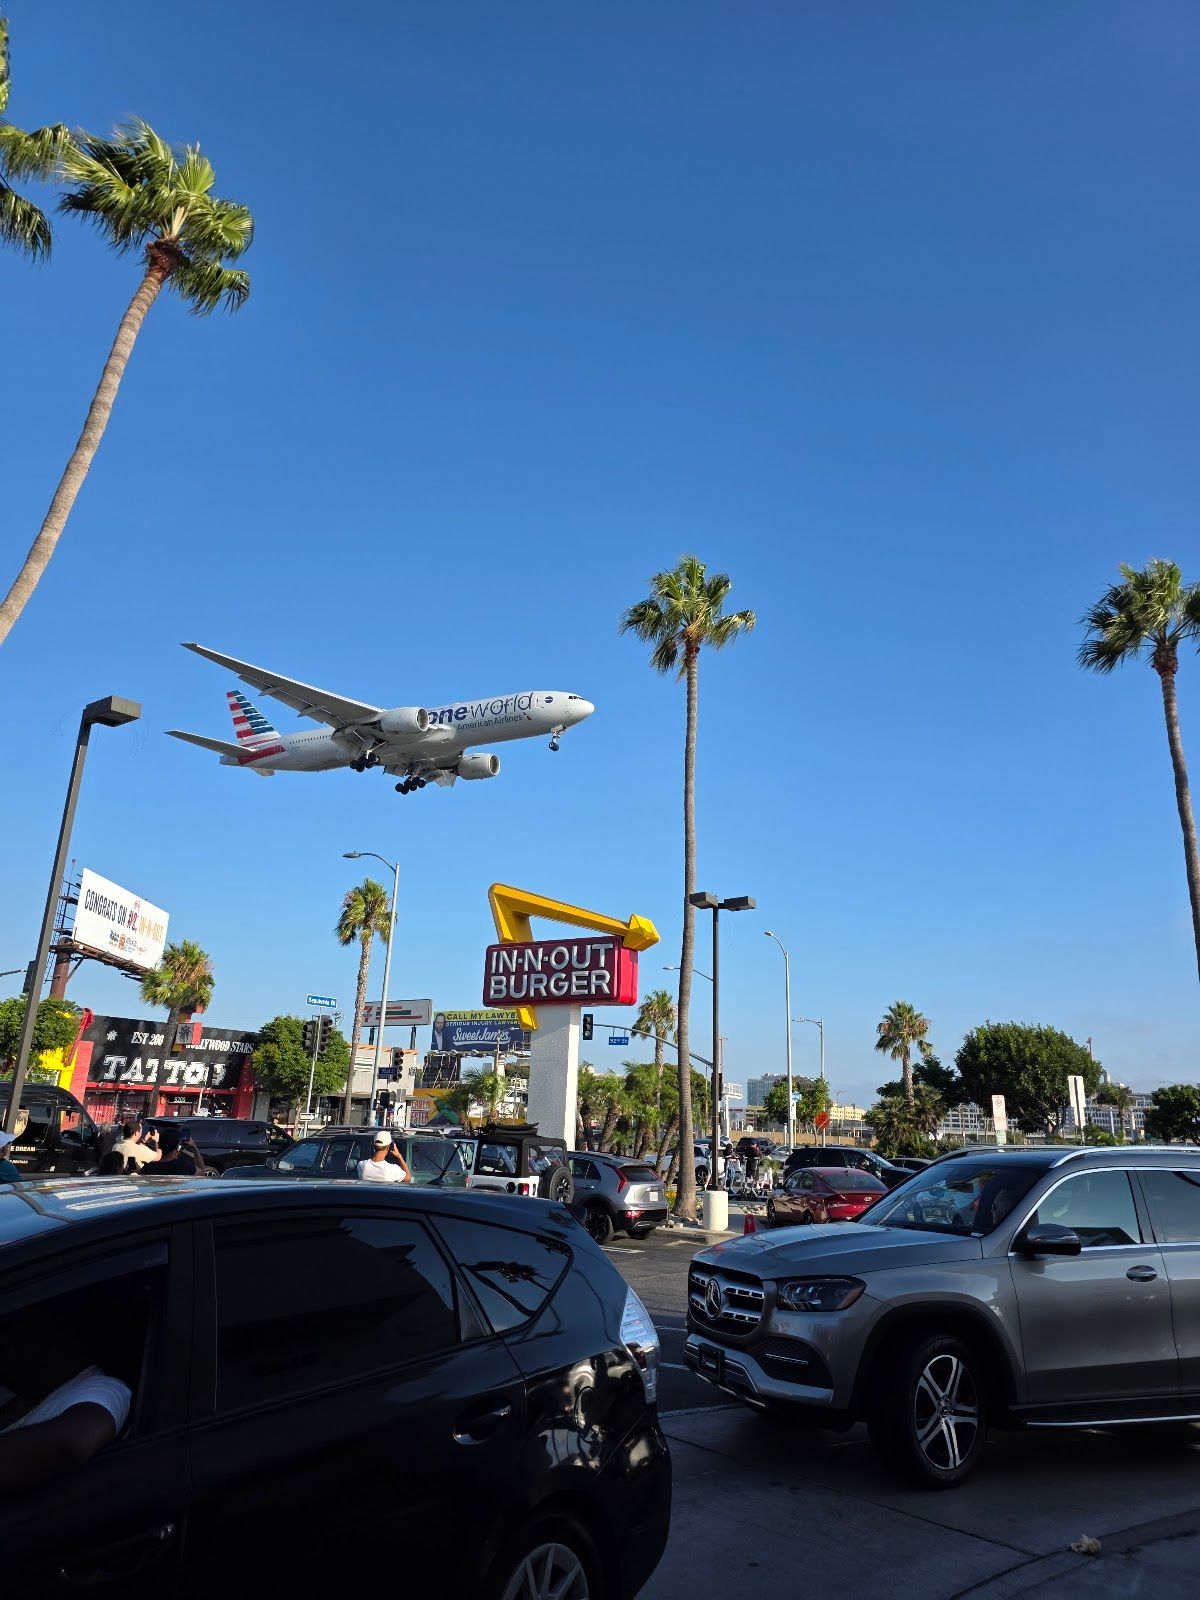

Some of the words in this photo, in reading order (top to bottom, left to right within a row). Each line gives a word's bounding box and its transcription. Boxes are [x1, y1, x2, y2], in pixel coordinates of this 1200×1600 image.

[457, 718, 493, 731] American
[494, 714, 523, 724] Airlines
[85, 889, 118, 921] CONGRATS
[118, 905, 127, 926] ON
[490, 943, 614, 974] IN-N-OUT
[489, 969, 611, 999] BURGER
[470, 1012, 484, 1020] MY
[485, 1011, 518, 1019] LAWYE
[131, 1031, 150, 1044] EST
[149, 1033, 165, 1046] 200
[453, 1027, 480, 1041] Sweet
[230, 1041, 254, 1054] STARS
